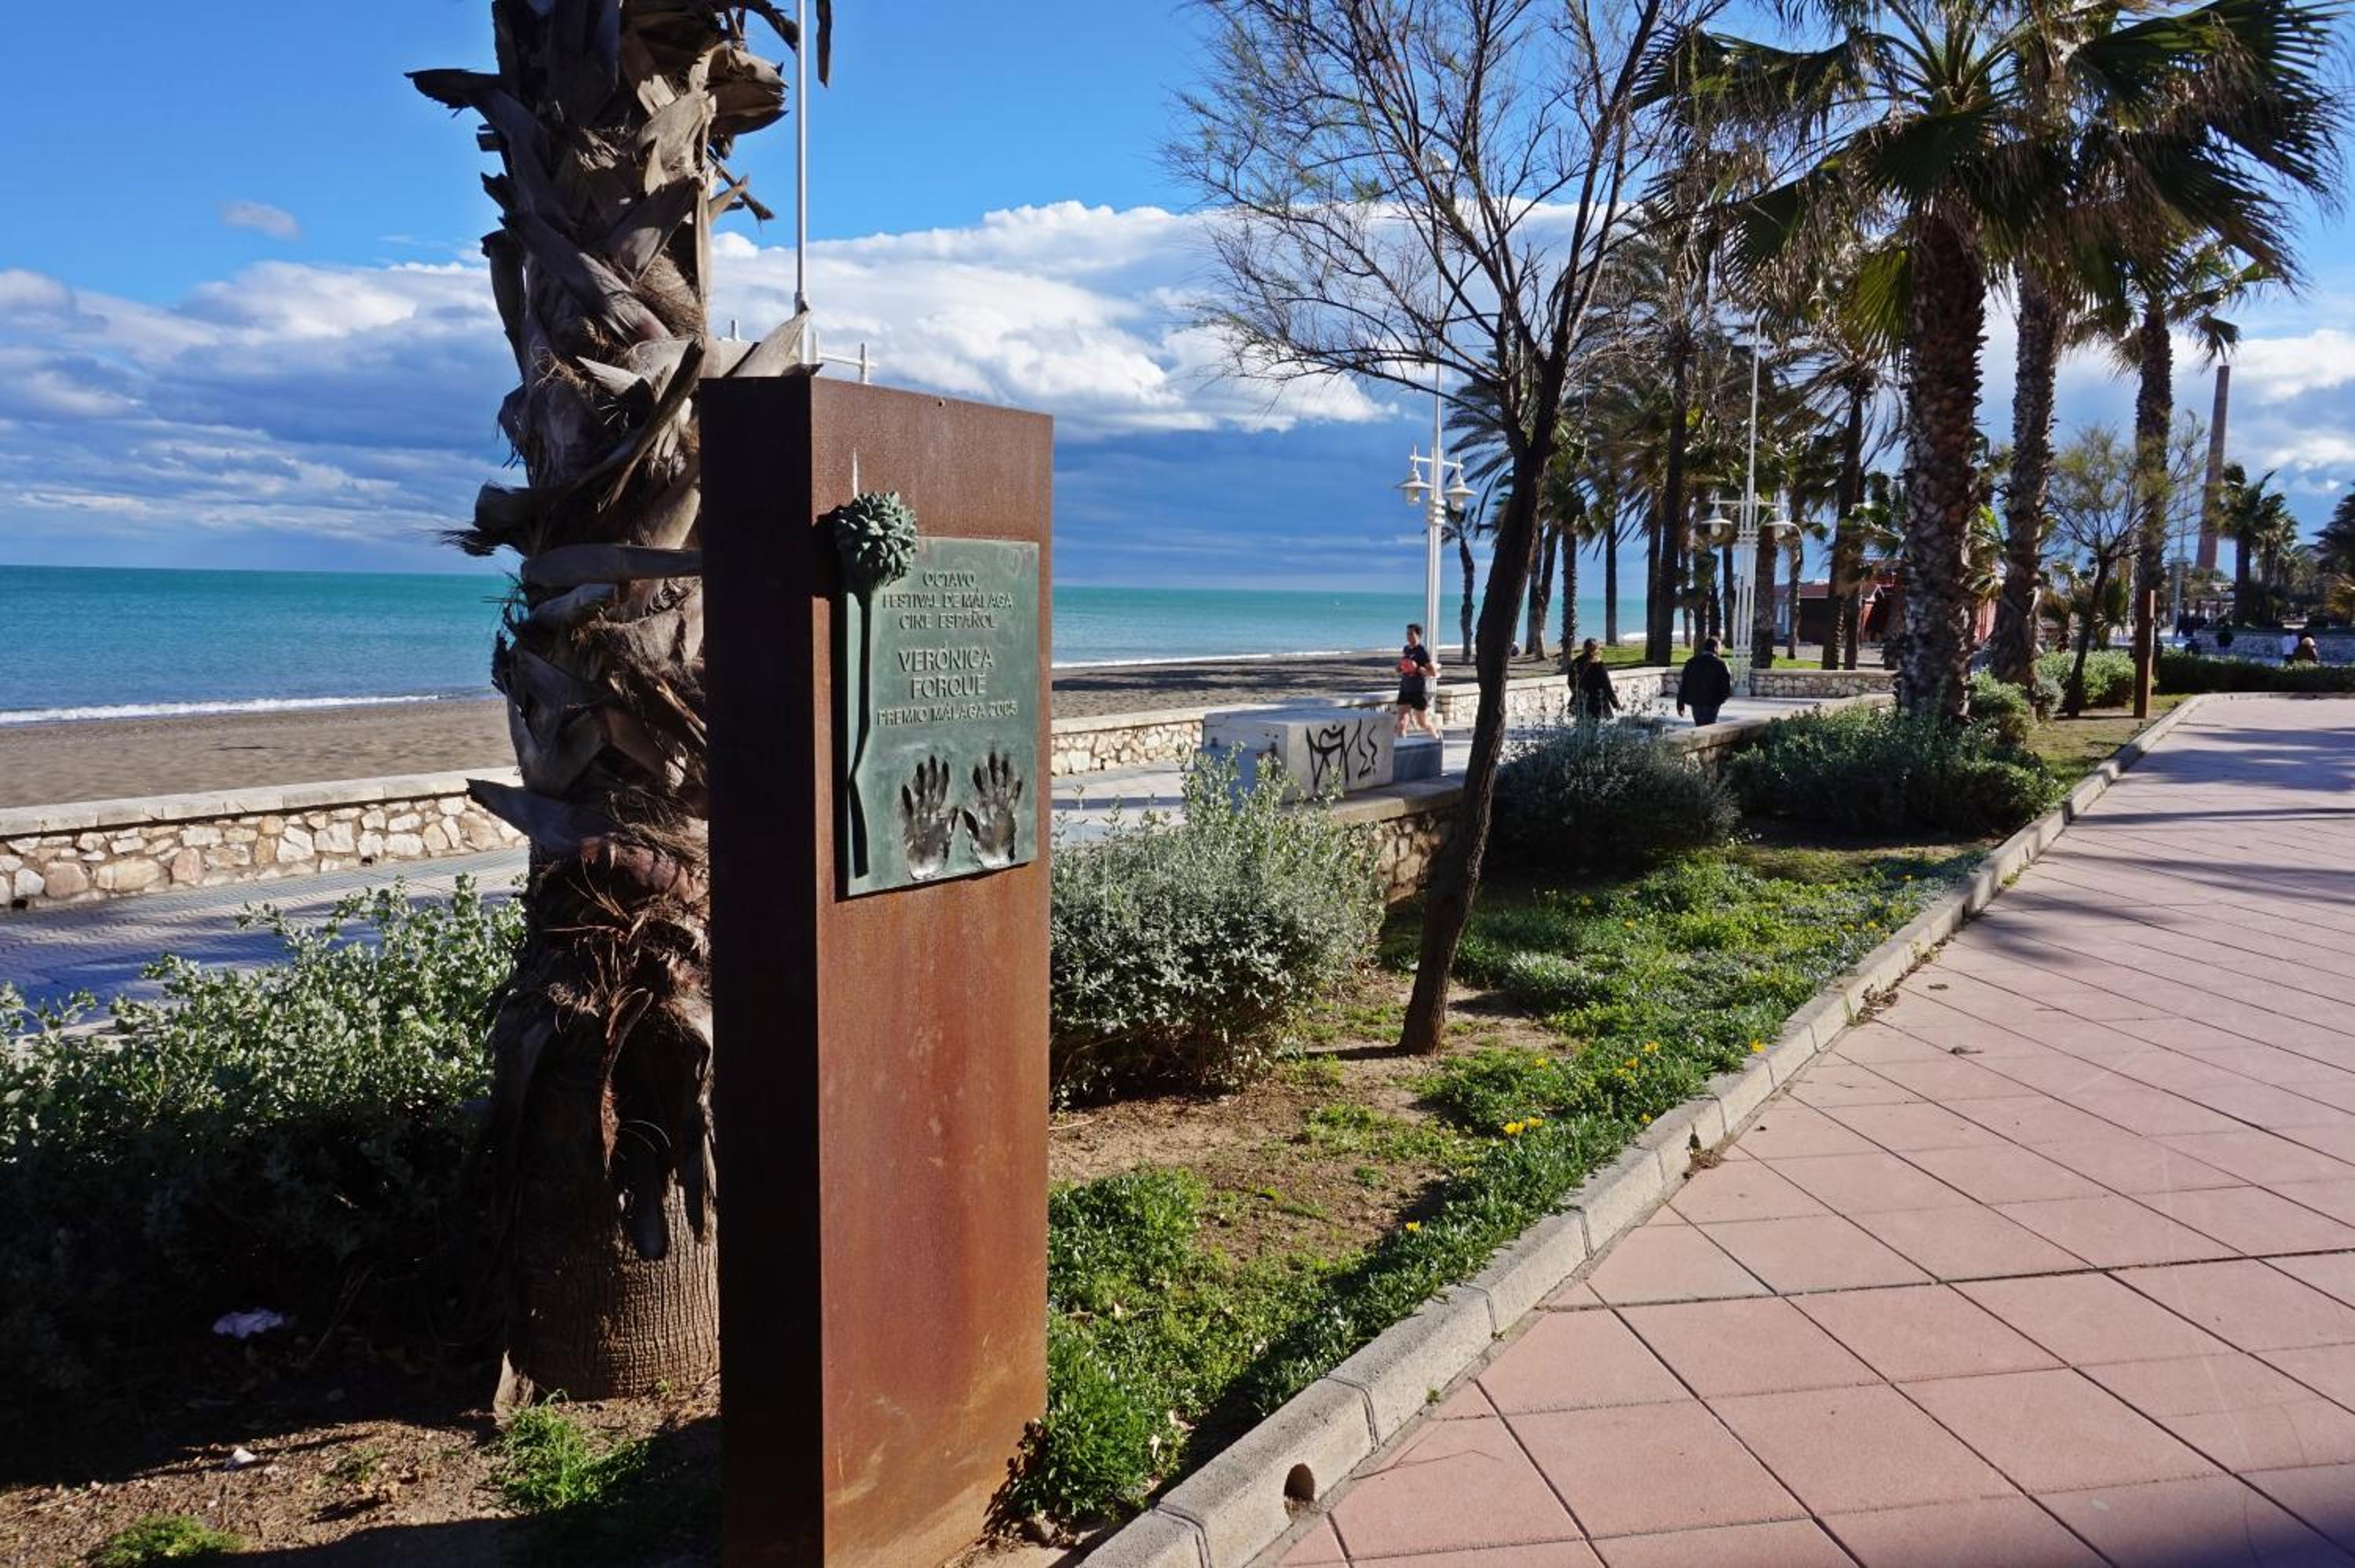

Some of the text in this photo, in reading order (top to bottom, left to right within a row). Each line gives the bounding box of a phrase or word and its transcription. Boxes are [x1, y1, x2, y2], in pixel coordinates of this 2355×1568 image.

[923, 571, 975, 587] OCTAVO
[882, 587, 1013, 608] FESTIVAL DE MÁLAGA
[900, 608, 999, 629] CINE ESPAÑOL
[898, 641, 994, 672] VERÓNICA
[911, 671, 987, 699] FORQUÉ
[878, 701, 1017, 726] PREMIO MÁLAGA 2005
